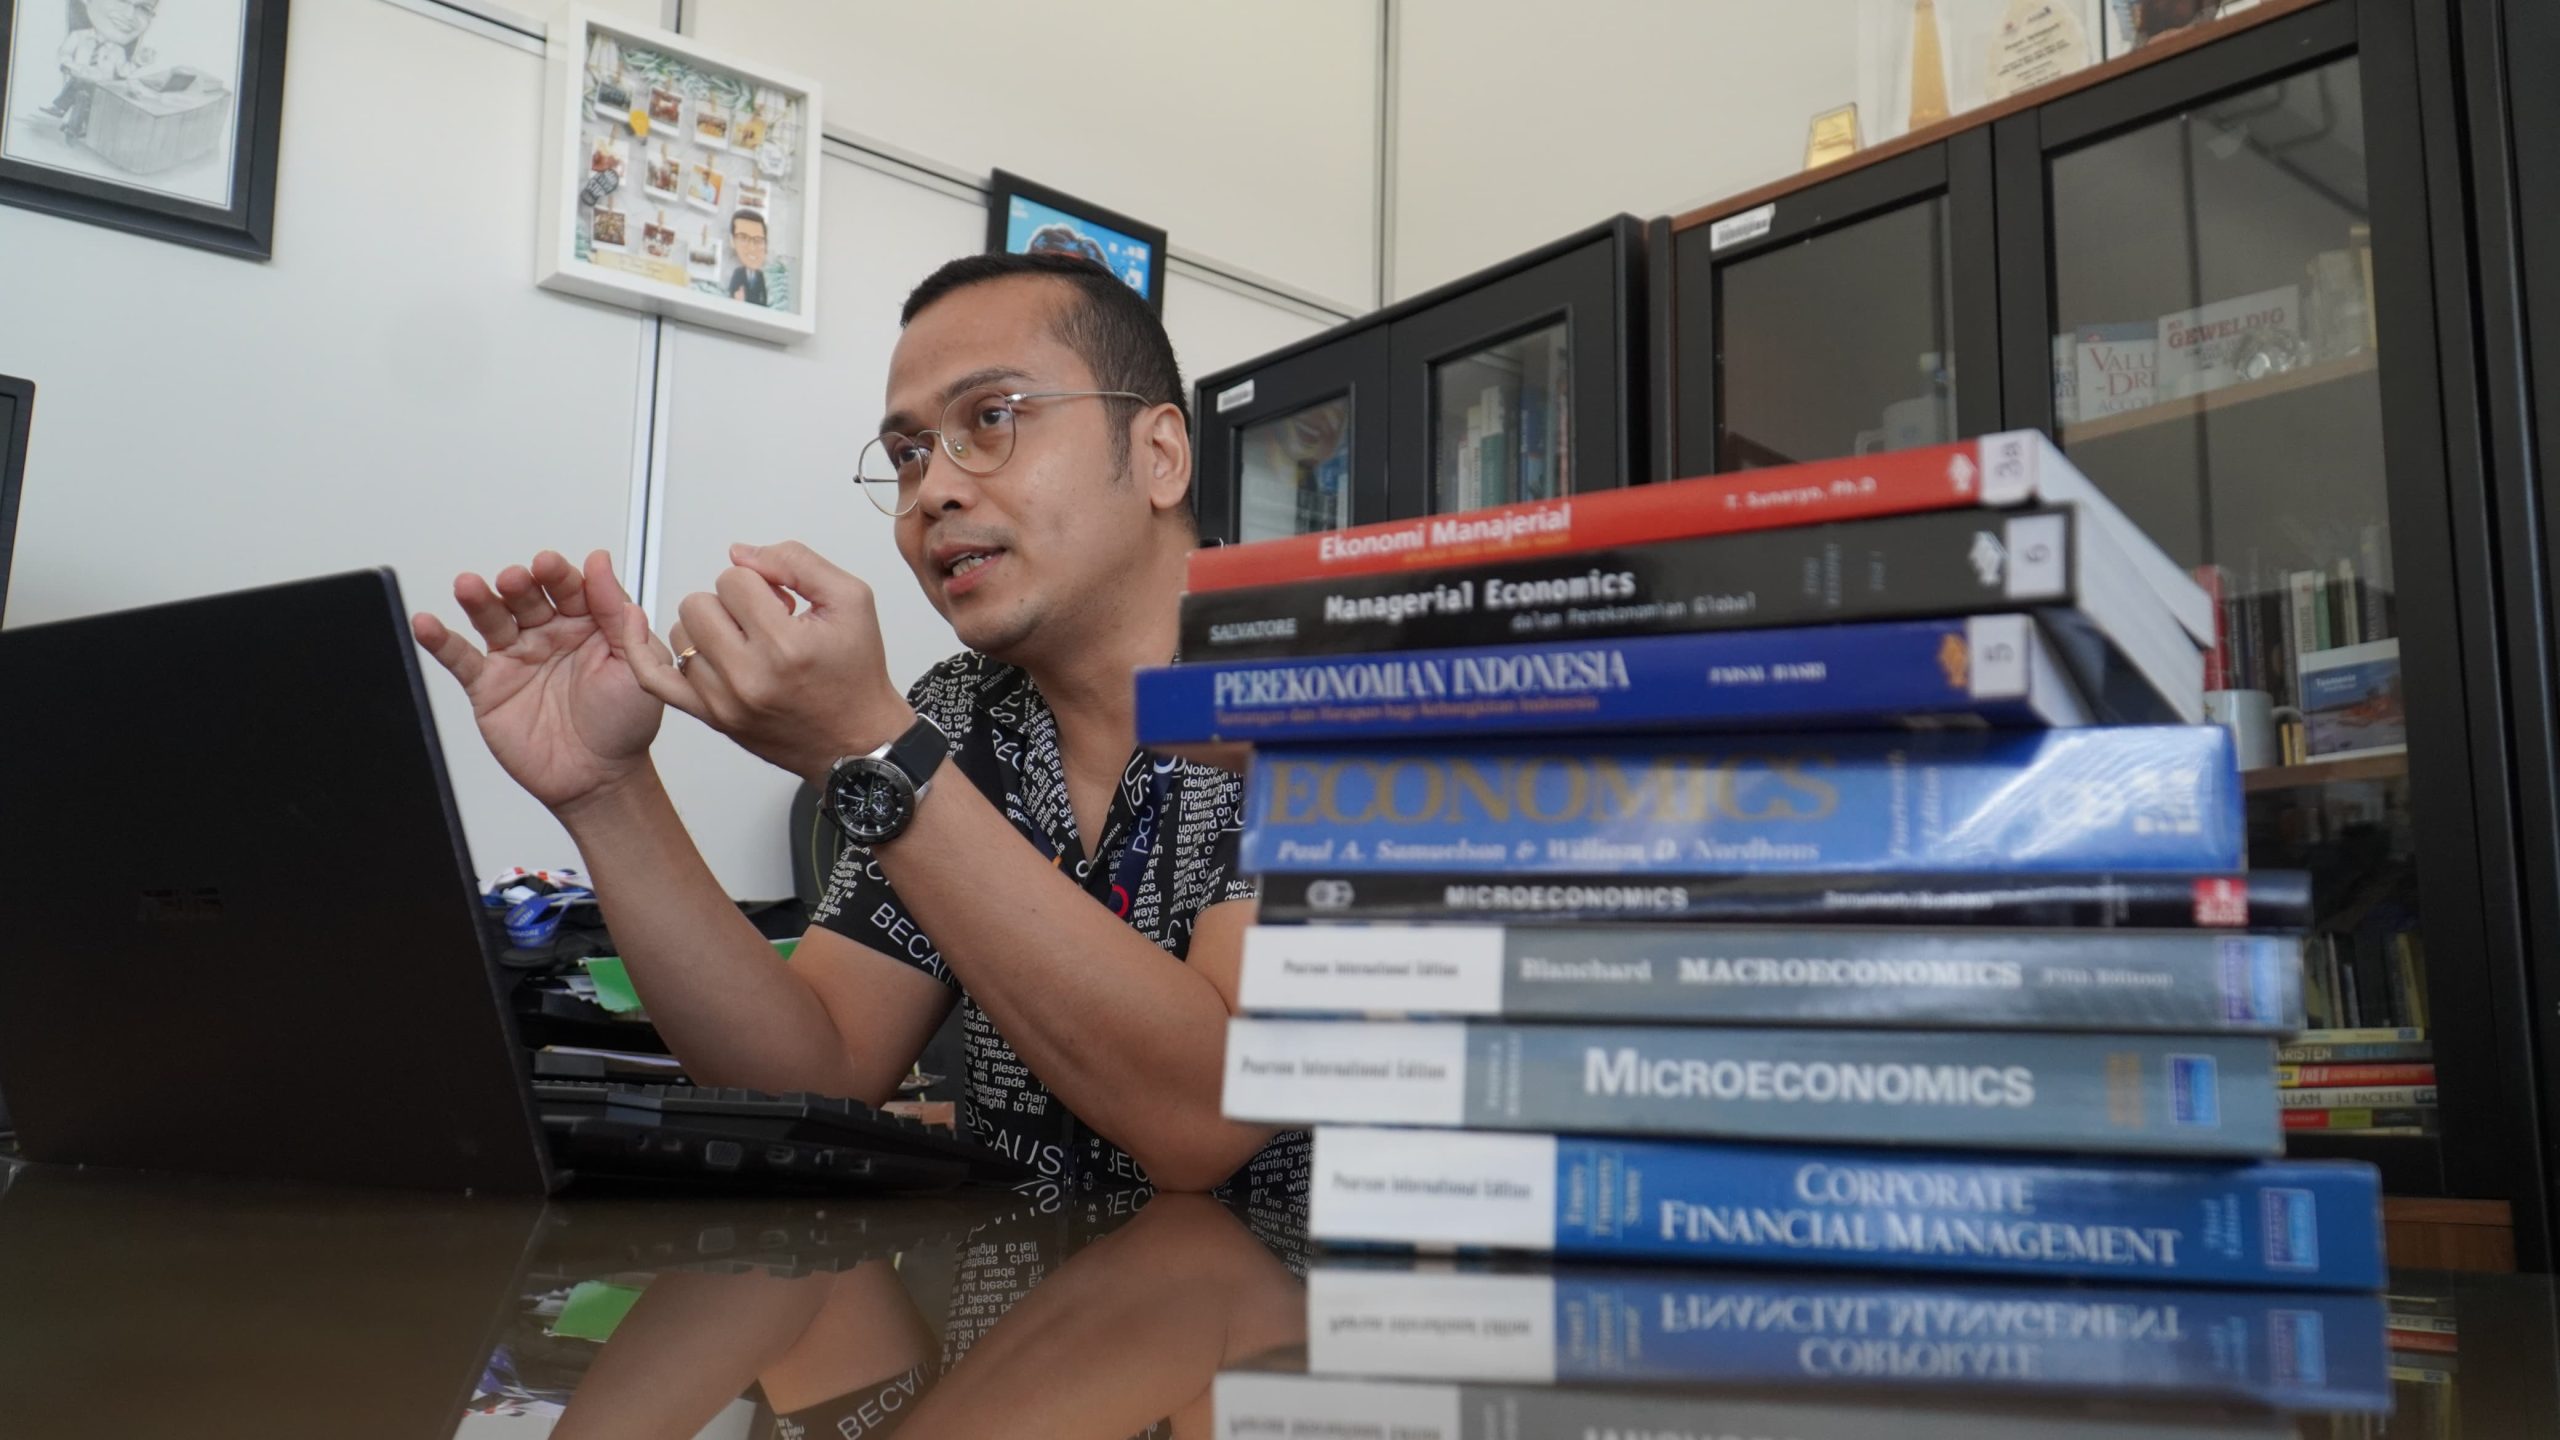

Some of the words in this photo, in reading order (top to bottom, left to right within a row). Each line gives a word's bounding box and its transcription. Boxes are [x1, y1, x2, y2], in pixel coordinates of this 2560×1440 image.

[1319, 521, 1425, 563] Ekonomi
[1430, 502, 1571, 547] Manajerial
[1324, 580, 1473, 623] Managerial
[1485, 568, 1636, 608] Economics
[1694, 591, 1757, 615] Global
[1209, 617, 1296, 645] SALVATORE
[1214, 660, 1447, 706] PEREKONOMIAN
[1453, 649, 1630, 696] INDONESIA
[1268, 753, 1840, 827] ECONOMICS
[1277, 839, 1336, 863] Paul
[1341, 840, 1366, 862] A.
[1375, 839, 1507, 862] Samuelson
[1515, 840, 1537, 862] &
[1443, 884, 1689, 911] MICROECONOMICS
[1519, 955, 1652, 983] Blanchard
[1678, 957, 2023, 989] MACROECONOMICS
[994, 1074, 1027, 1089] made
[1583, 1046, 2035, 1108] MICROECONOMICS
[1012, 1100, 1025, 1113] to
[1249, 1156, 1293, 1172] wanting
[1289, 1166, 1309, 1180] out
[1796, 1161, 2034, 1215] CORPORATE
[1658, 1199, 1872, 1249] FINANCIAL
[1884, 1213, 2182, 1268] MANAGEMENT
